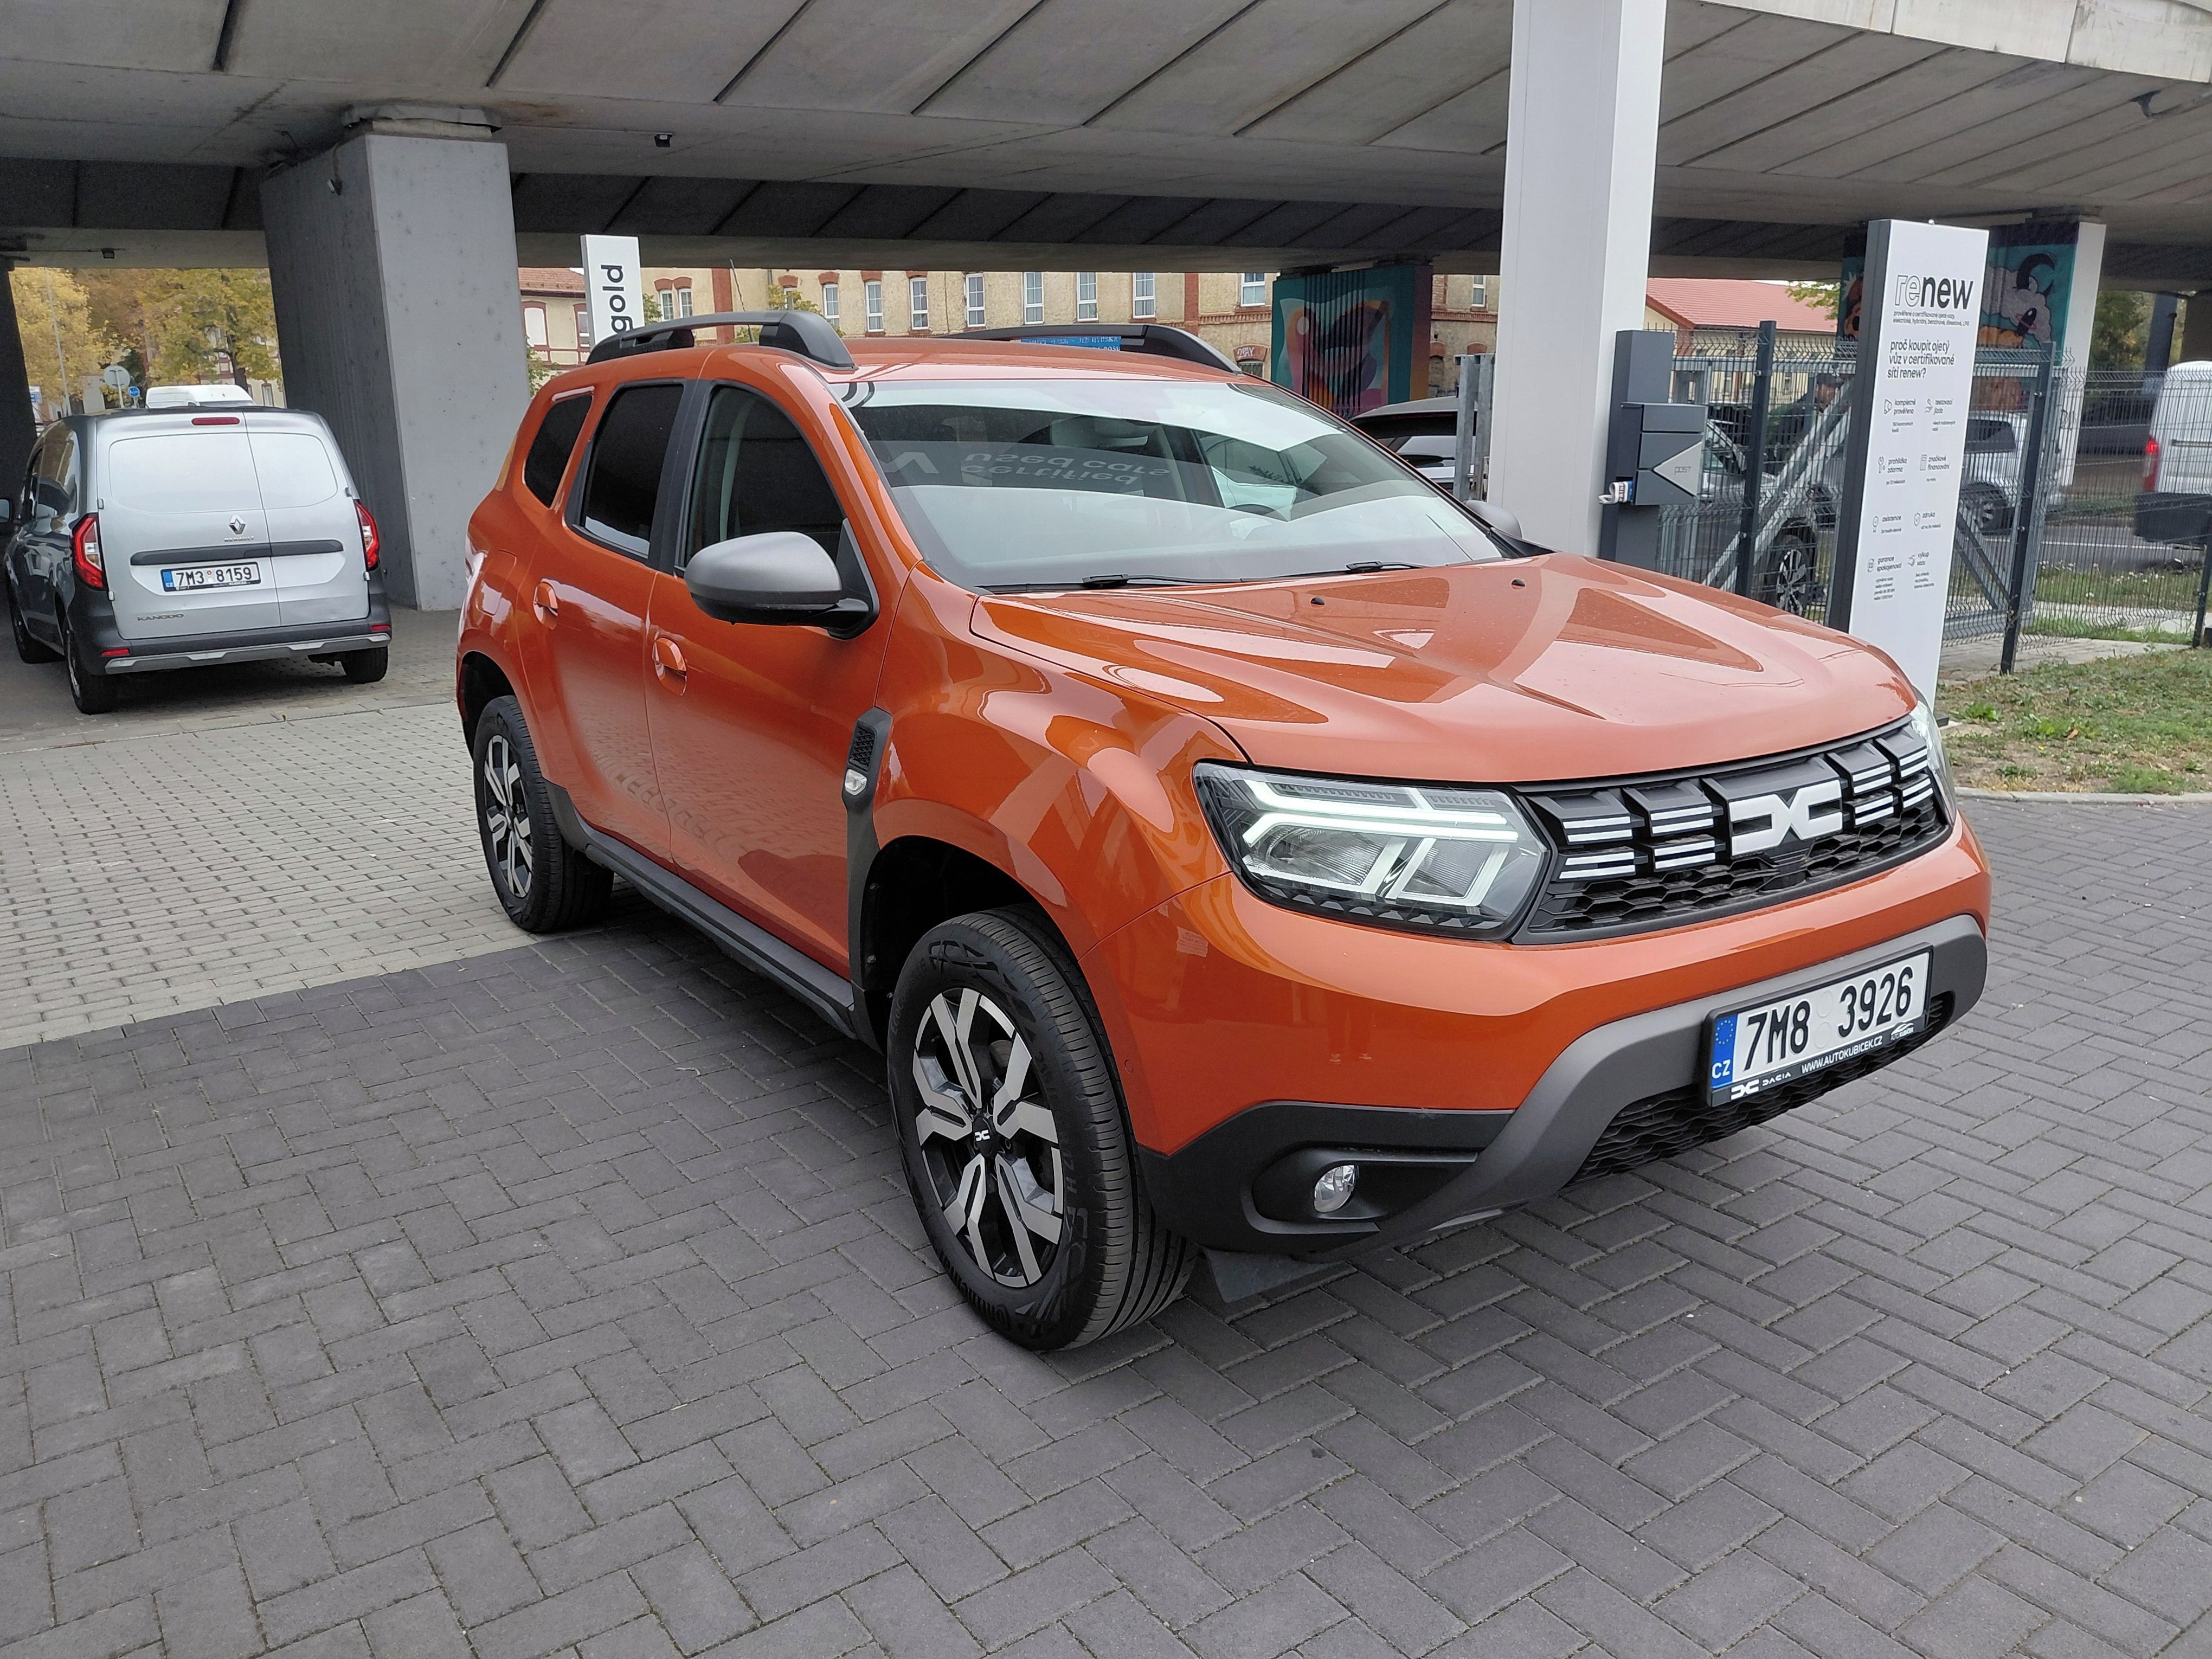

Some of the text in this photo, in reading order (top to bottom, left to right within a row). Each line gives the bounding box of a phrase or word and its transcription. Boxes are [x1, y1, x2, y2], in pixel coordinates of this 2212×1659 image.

[601, 265, 633, 334] gold
[1894, 274, 1973, 310] renew
[1890, 339, 1950, 355] proč koupit ojetý
[1889, 351, 1954, 365] vůz v certifikované
[1900, 367, 1926, 378] renew?
[176, 571, 204, 587] 7M3
[216, 567, 252, 582] 8159
[137, 613, 184, 621] KANGOO
[1743, 966, 1914, 1072] 7M8 3926
[1801, 1035, 1883, 1074] WWW.AUTOKUBICEK.CZ
[1712, 1059, 1731, 1079] CZ
[1762, 1071, 1792, 1086] DACIA
